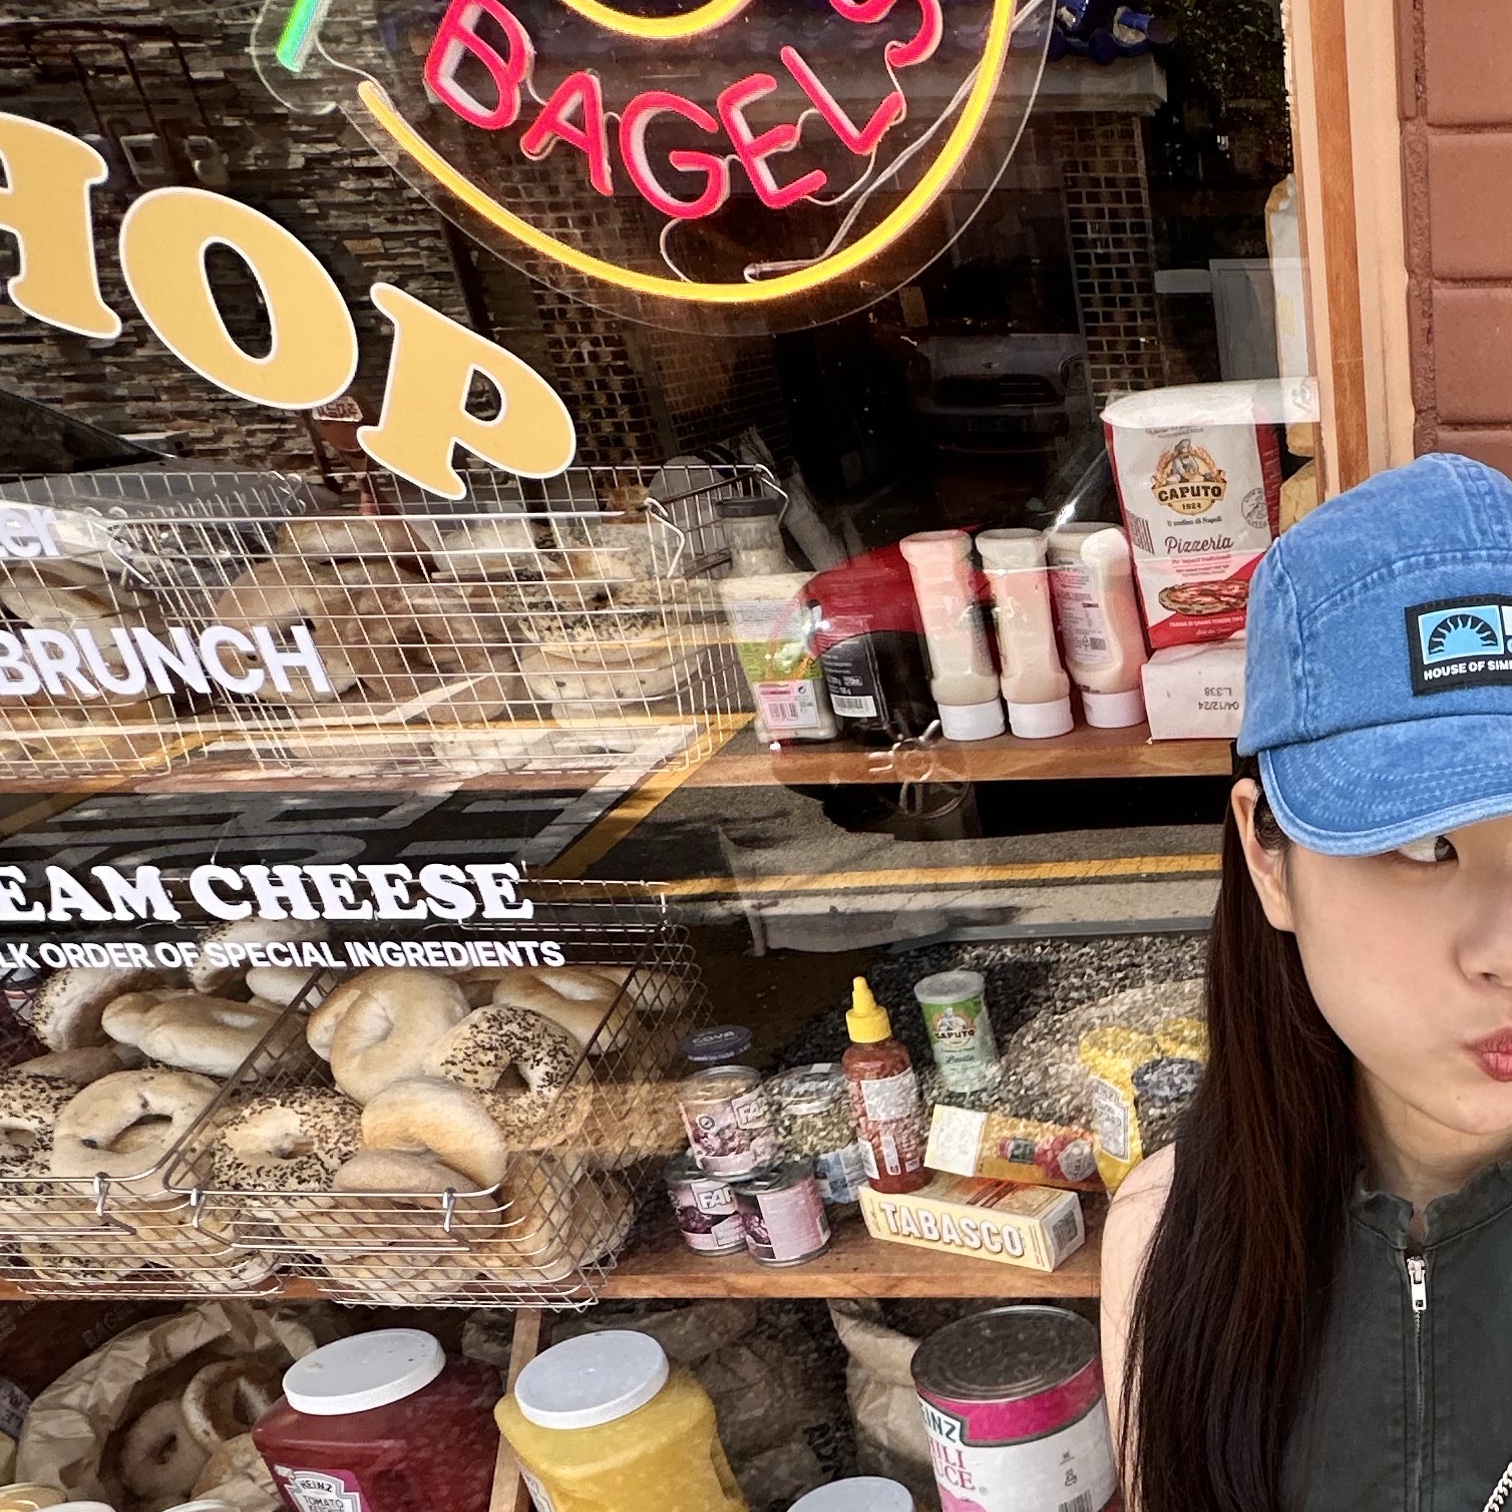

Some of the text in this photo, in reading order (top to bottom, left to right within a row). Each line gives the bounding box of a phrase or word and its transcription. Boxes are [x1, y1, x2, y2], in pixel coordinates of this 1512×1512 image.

[1157, 485, 1223, 502] CAPUTO
[0, 506, 60, 557] er
[1164, 533, 1234, 555] Pizzeria
[0, 625, 332, 696] BRUNCH
[1423, 662, 1467, 681] HOUSE
[1469, 661, 1487, 673] OF
[0, 863, 535, 922] EAM CHEESE
[38, 941, 156, 968] ORDER
[154, 941, 200, 968] OF
[206, 940, 347, 968] SPECIAL
[344, 940, 566, 968] INGREDIENTS
[879, 1201, 1025, 1258] TABASCO
[302, 1494, 345, 1510] TOMATO
